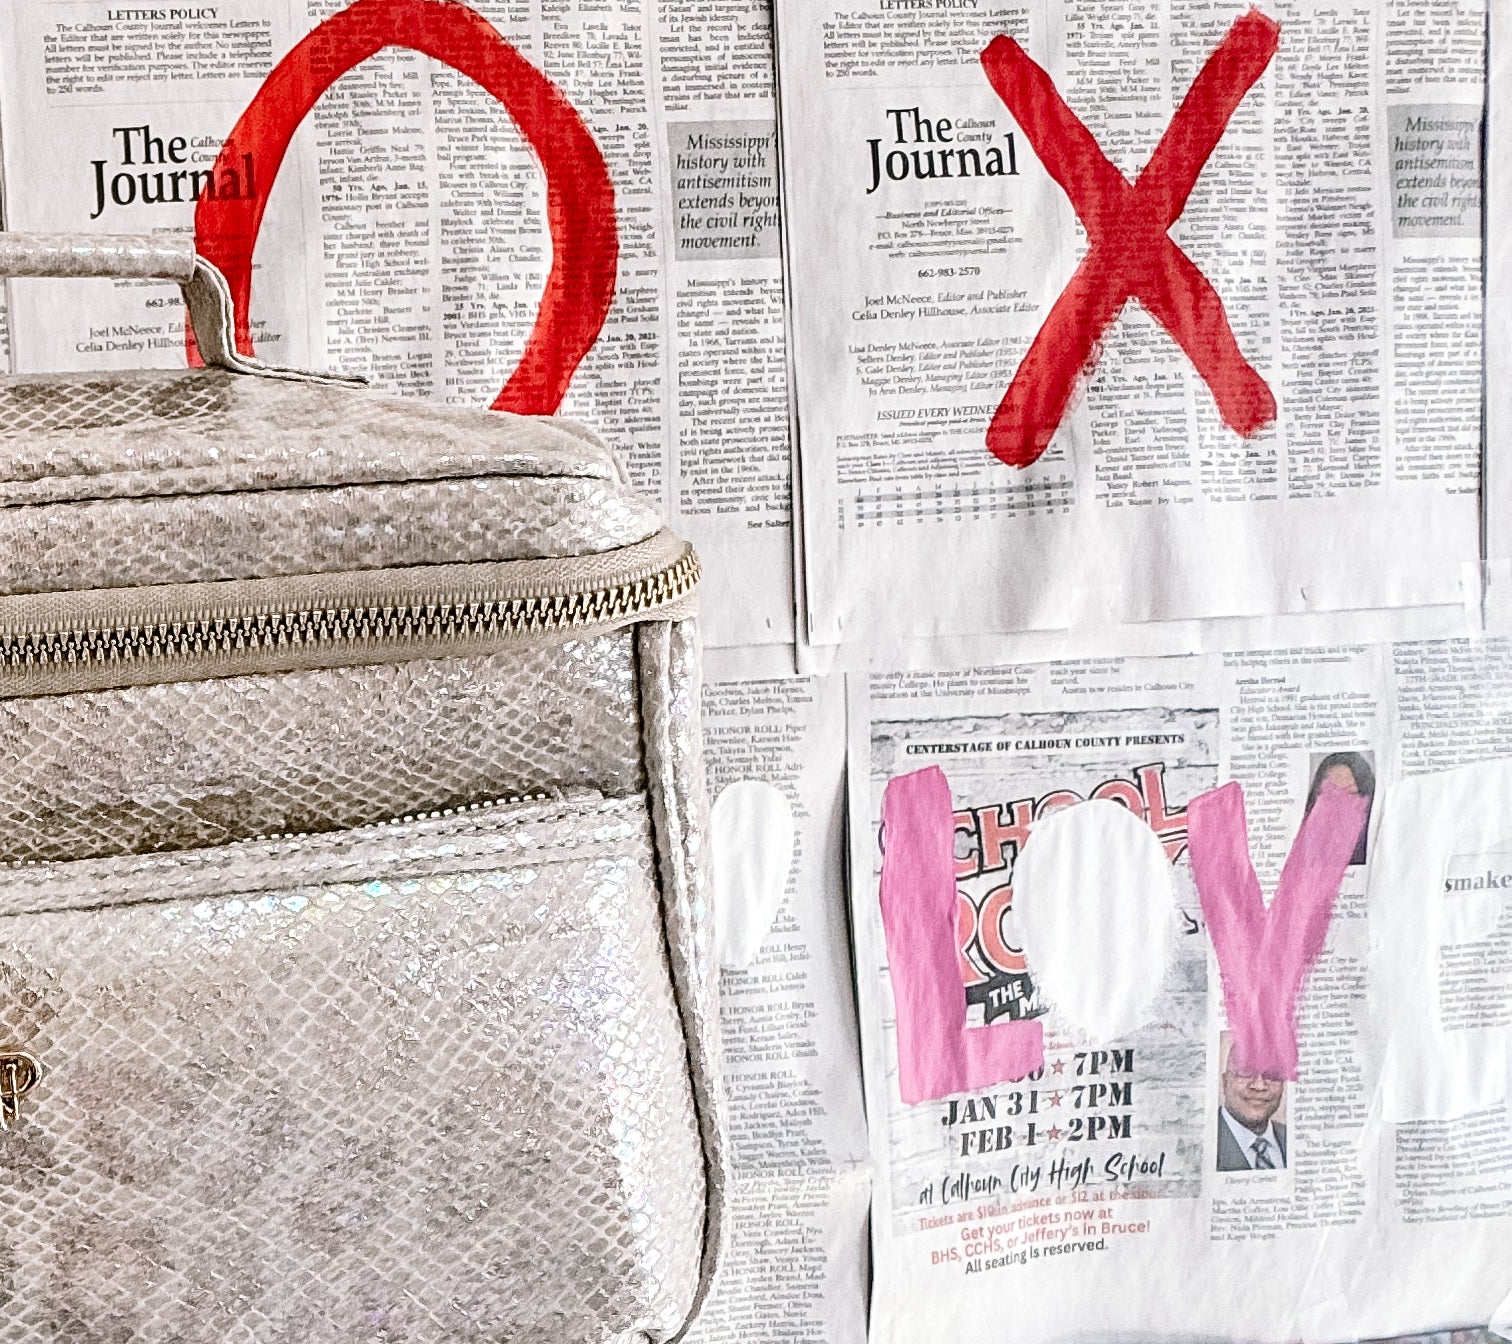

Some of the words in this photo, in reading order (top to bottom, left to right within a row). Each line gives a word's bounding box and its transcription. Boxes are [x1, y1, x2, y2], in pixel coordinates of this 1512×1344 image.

[107, 9, 166, 20] LETTERS
[169, 7, 217, 19] POLICY
[886, 107, 955, 145] The
[951, 118, 995, 129] Calhoun
[952, 131, 992, 144] County
[113, 125, 187, 165] The
[671, 152, 728, 175] history
[733, 149, 765, 168] with
[866, 133, 1020, 194] Journal
[90, 152, 257, 219] Journal
[676, 170, 772, 188] antisemitism
[672, 192, 734, 210] extends
[674, 213, 702, 229] the
[706, 211, 746, 229] civil
[675, 232, 760, 249] movement.
[981, 6, 1281, 469] X
[1073, 1048, 1134, 1077] 7PM
[940, 1094, 998, 1127] JAN
[1004, 1090, 1040, 1115] 31
[1073, 1080, 1134, 1110] 7PM
[960, 1125, 1014, 1157] FEB
[1022, 1122, 1043, 1146] 1
[1067, 1113, 1133, 1144] 2PM
[919, 1183, 933, 1204] at
[941, 1172, 1001, 1205] Calhoun
[1010, 1164, 1041, 1193] City
[1047, 1156, 1100, 1190] High
[1103, 1152, 1165, 1184] School
[964, 1258, 982, 1274] All
[984, 1249, 1026, 1270] seating
[1029, 1245, 1039, 1258] is
[1043, 1236, 1108, 1257] reserved.
